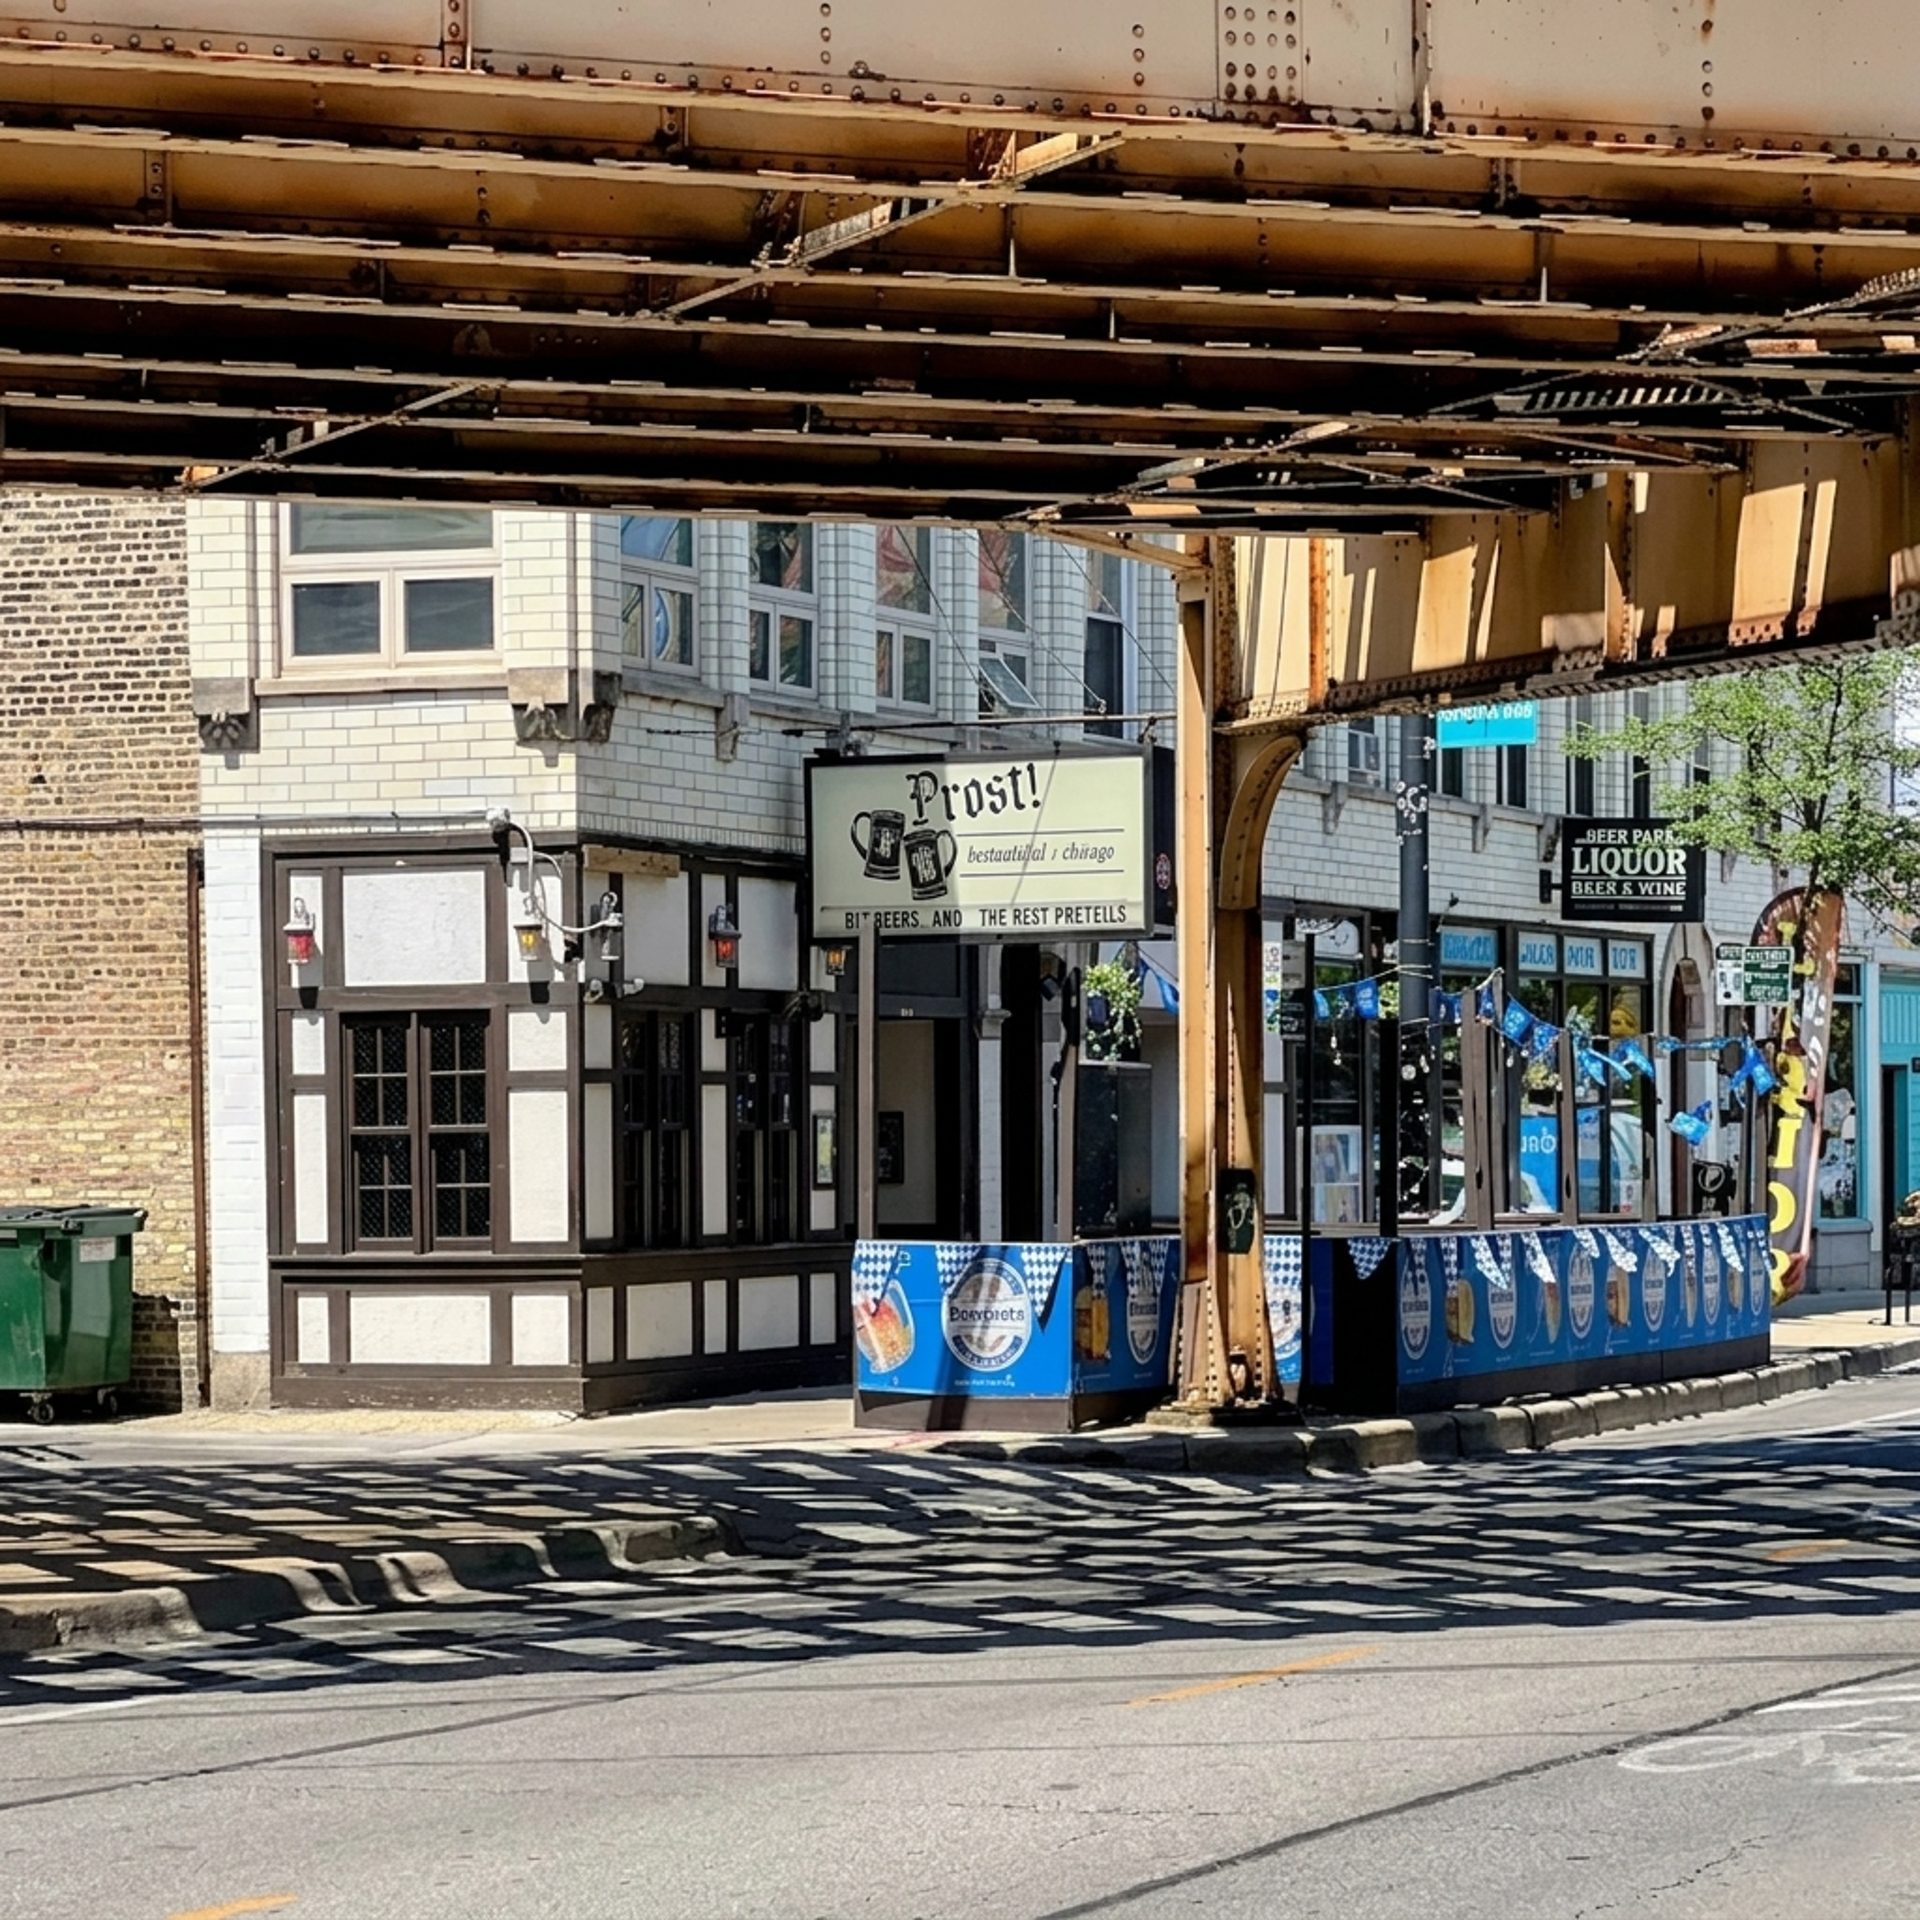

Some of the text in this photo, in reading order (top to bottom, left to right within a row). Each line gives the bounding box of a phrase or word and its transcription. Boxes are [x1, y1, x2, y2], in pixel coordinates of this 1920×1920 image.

[906, 763, 1040, 825] Prost!
[1571, 847, 1687, 879] LIQUOR
[1572, 881, 1617, 895] BEER
[1638, 882, 1686, 895] WINE
[932, 909, 963, 927] AND
[979, 908, 1007, 926] THE
[1013, 907, 1049, 925] REST
